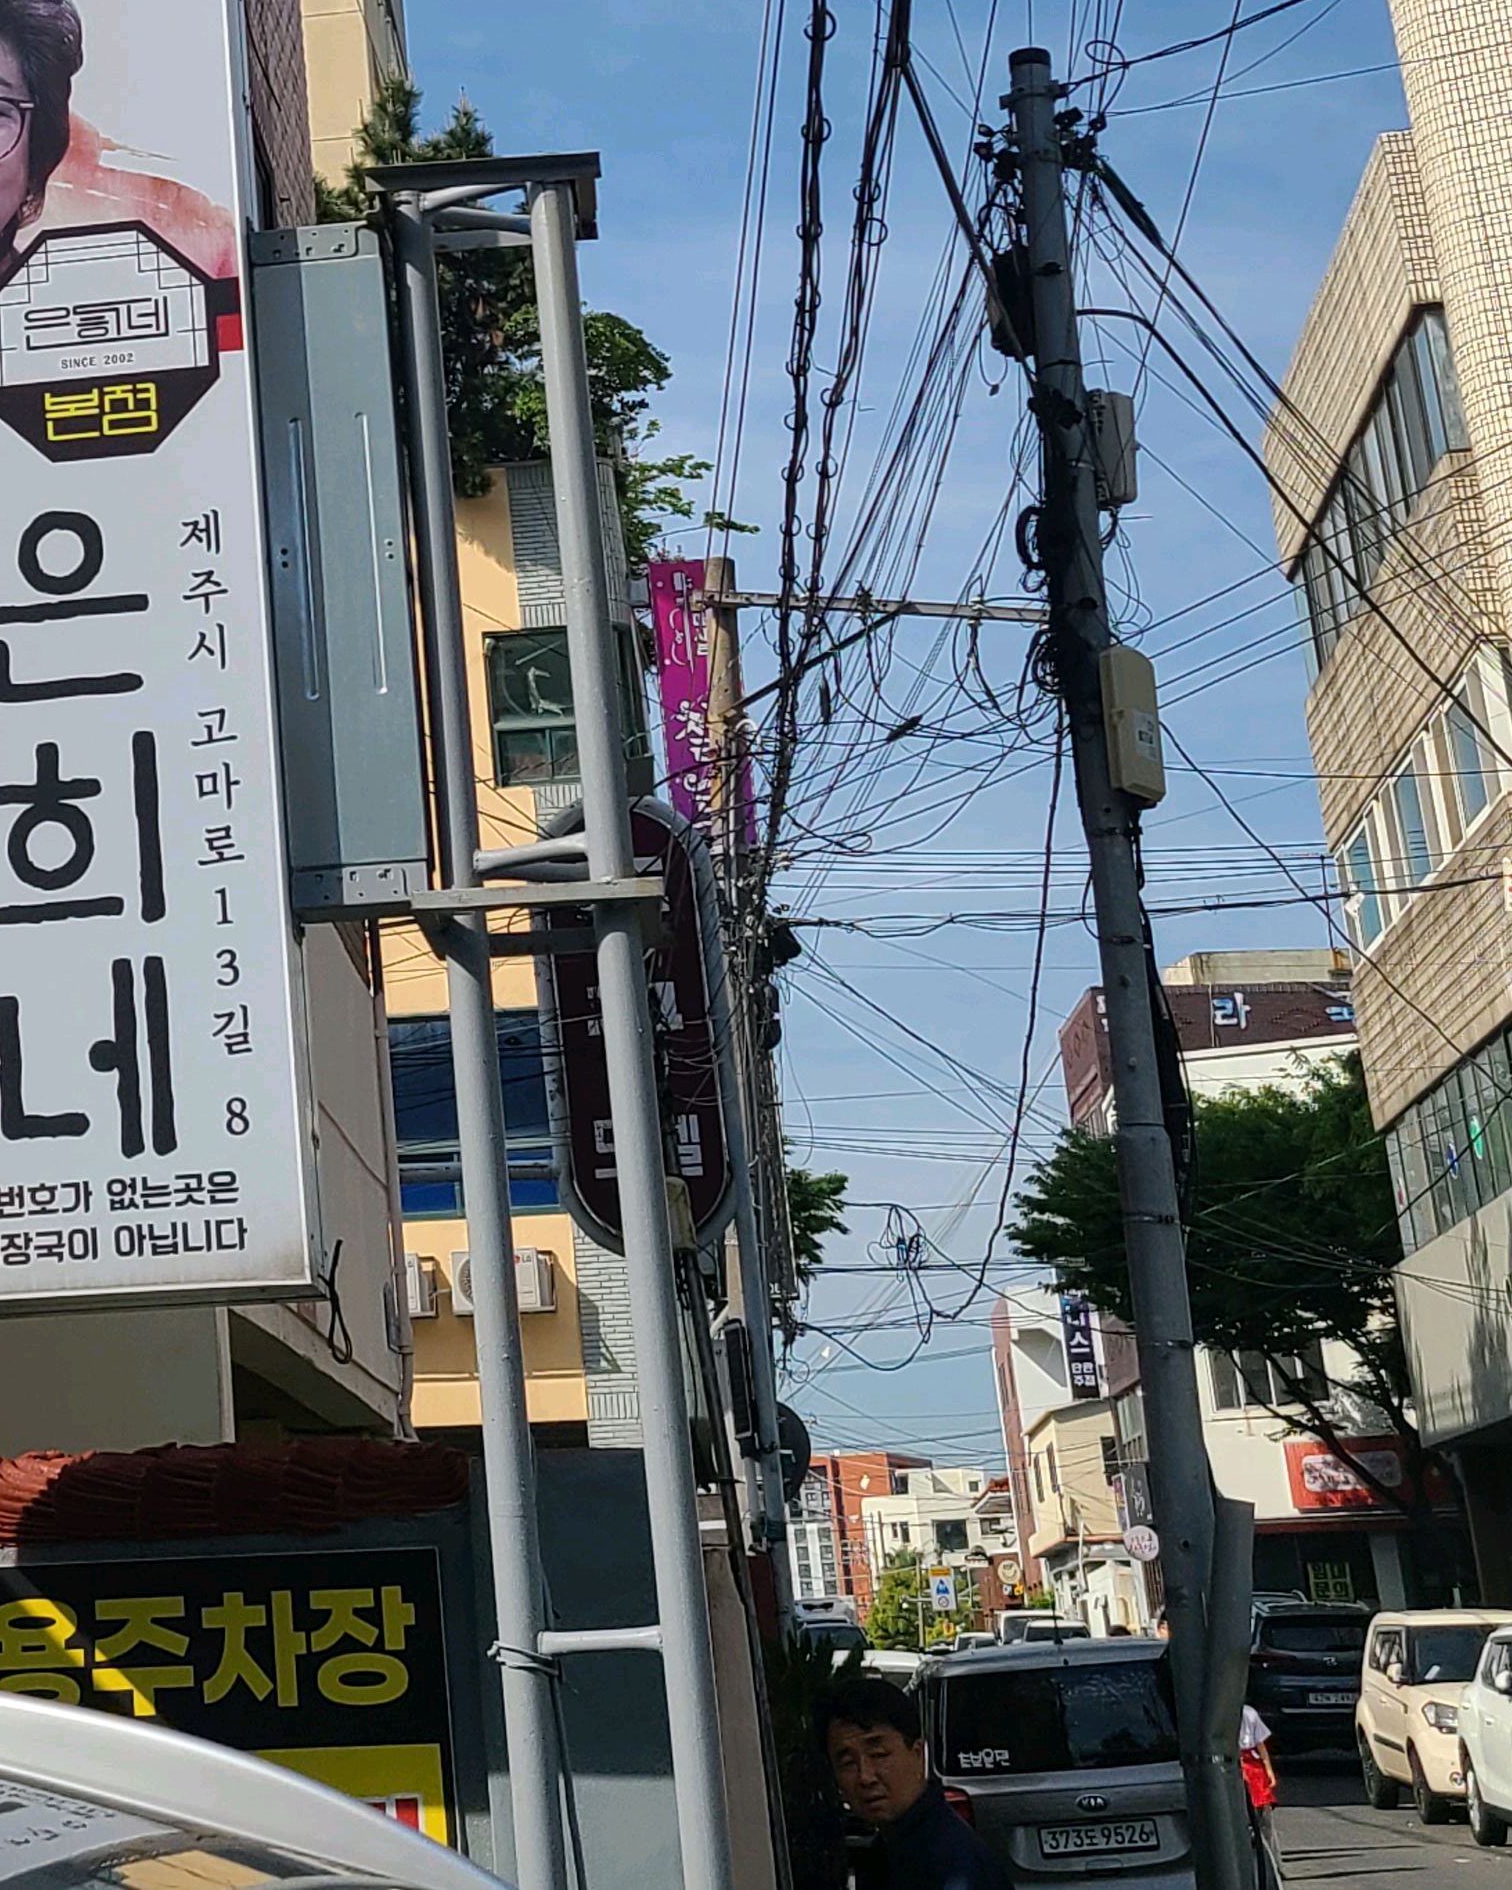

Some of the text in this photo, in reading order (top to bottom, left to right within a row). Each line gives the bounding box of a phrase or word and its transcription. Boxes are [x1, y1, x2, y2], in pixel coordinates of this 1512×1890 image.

[60, 352, 135, 370] SINCE 2002
[44, 382, 159, 442] 본점
[179, 508, 253, 1137] 제주시 고마로13길 8
[106, 1170, 240, 1213] 없는곳은
[113, 1217, 248, 1259] 아닙니다
[1081, 1796, 1105, 1807] KIA
